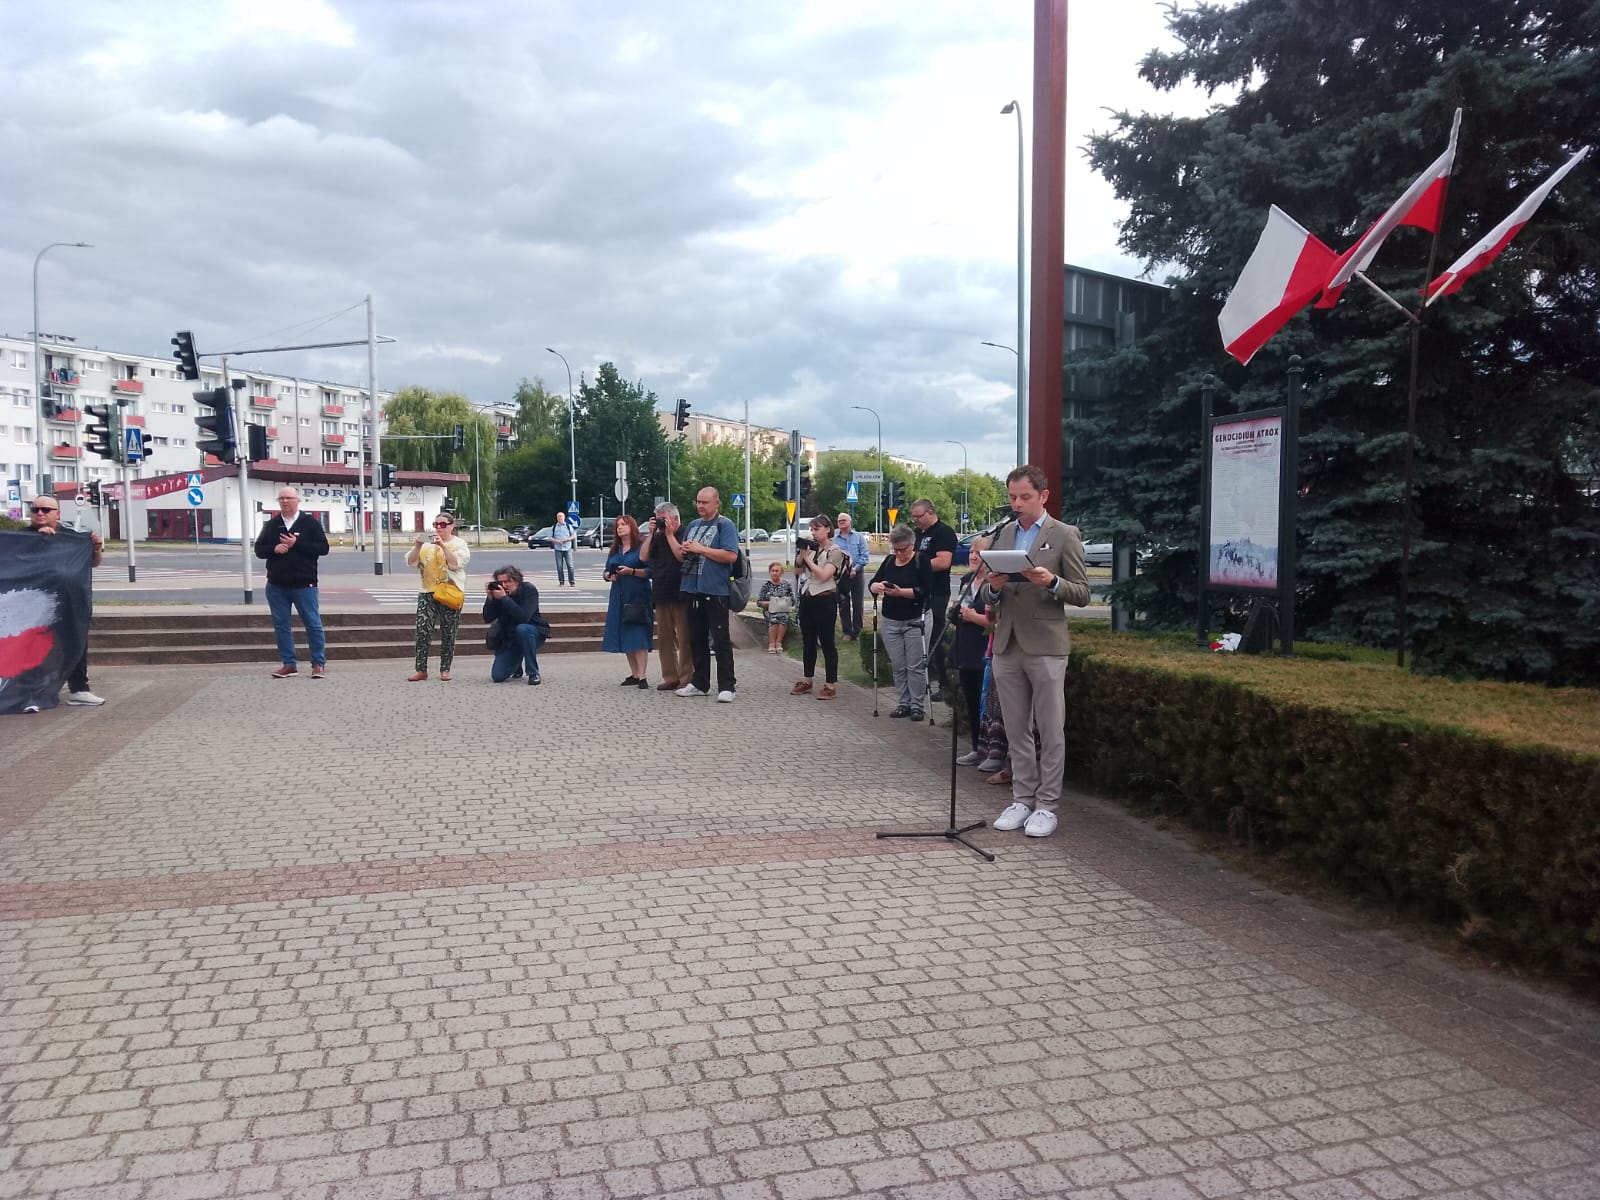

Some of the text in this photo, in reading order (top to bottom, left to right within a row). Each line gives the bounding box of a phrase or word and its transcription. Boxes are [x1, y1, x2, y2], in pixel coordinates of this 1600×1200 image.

[1215, 428, 1279, 442] GENOCIDIUM ATROX
[295, 488, 402, 499] POROY
